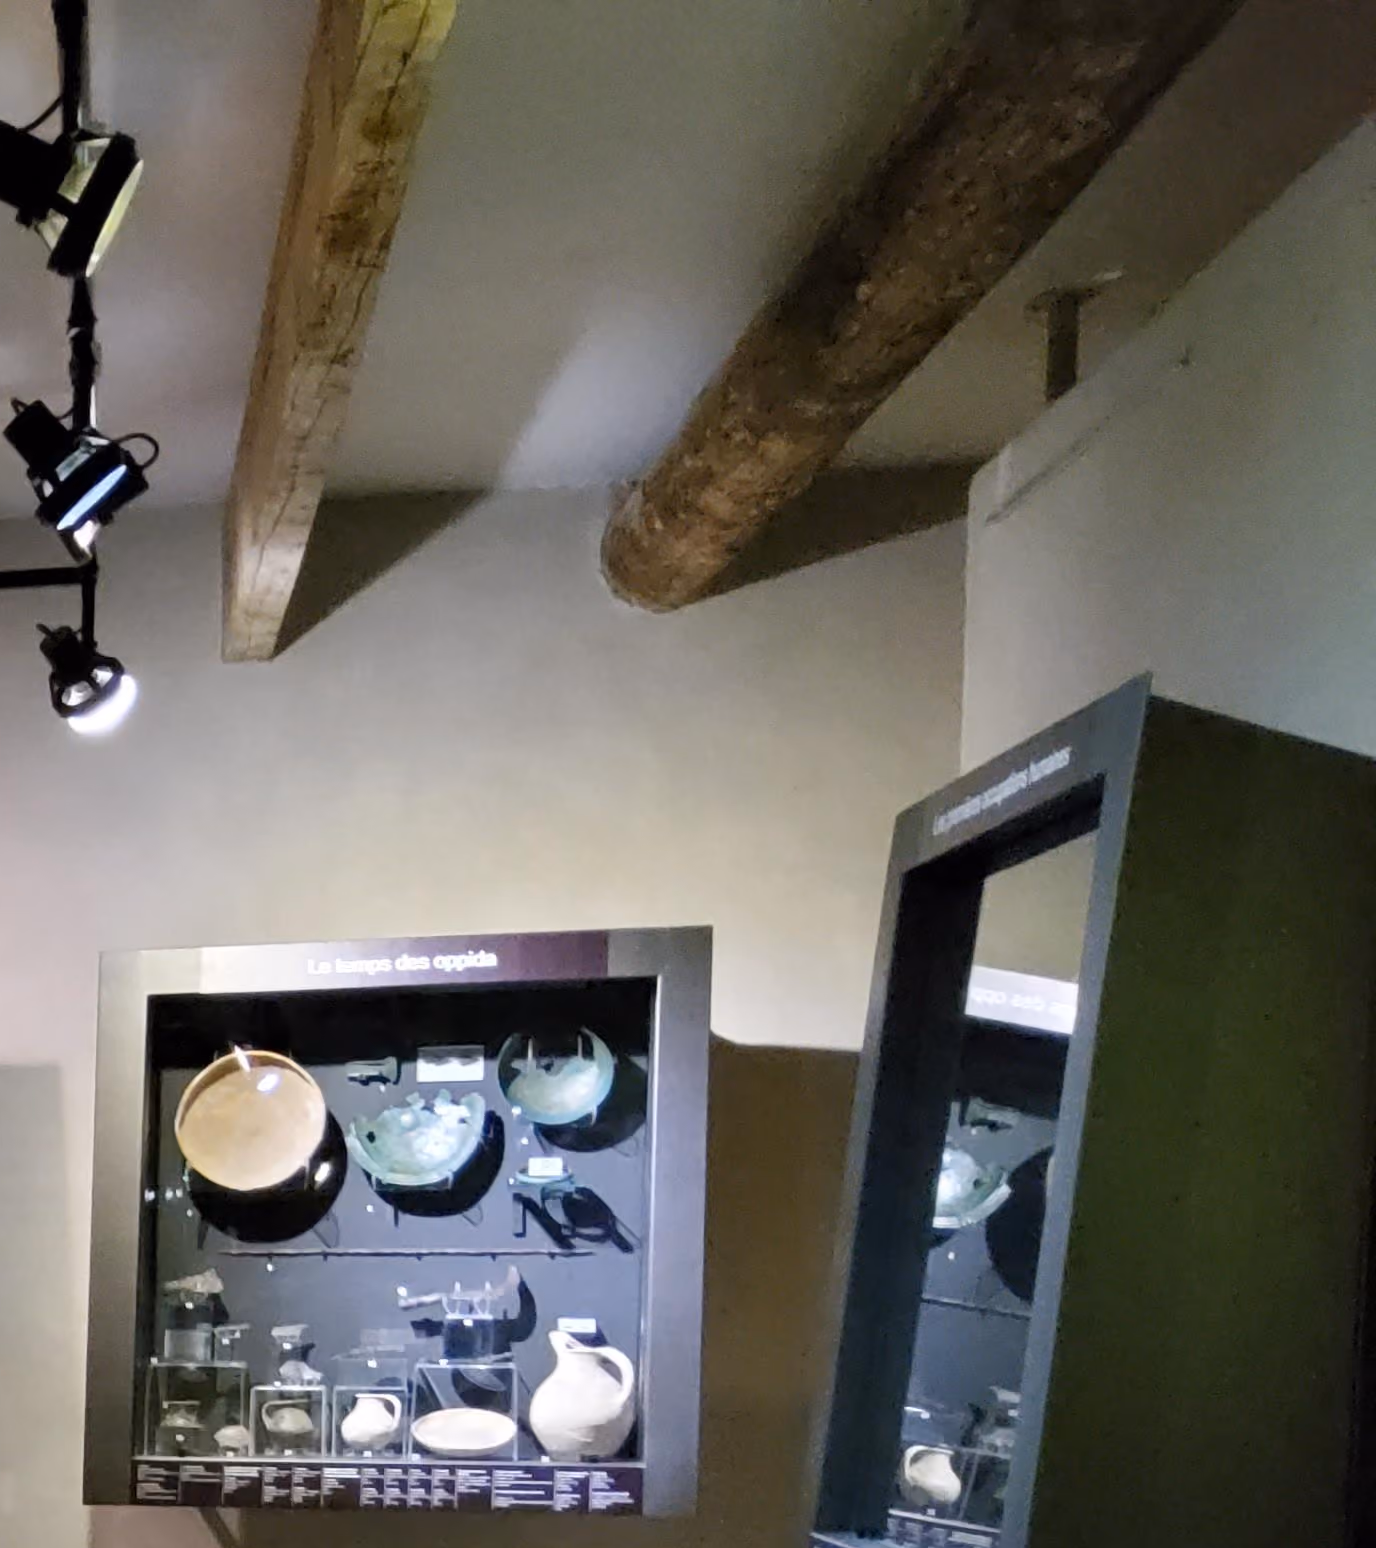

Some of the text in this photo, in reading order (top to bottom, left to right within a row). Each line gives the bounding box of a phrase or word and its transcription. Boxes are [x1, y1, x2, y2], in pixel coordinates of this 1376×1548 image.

[307, 950, 497, 975] Le temps des oppida
